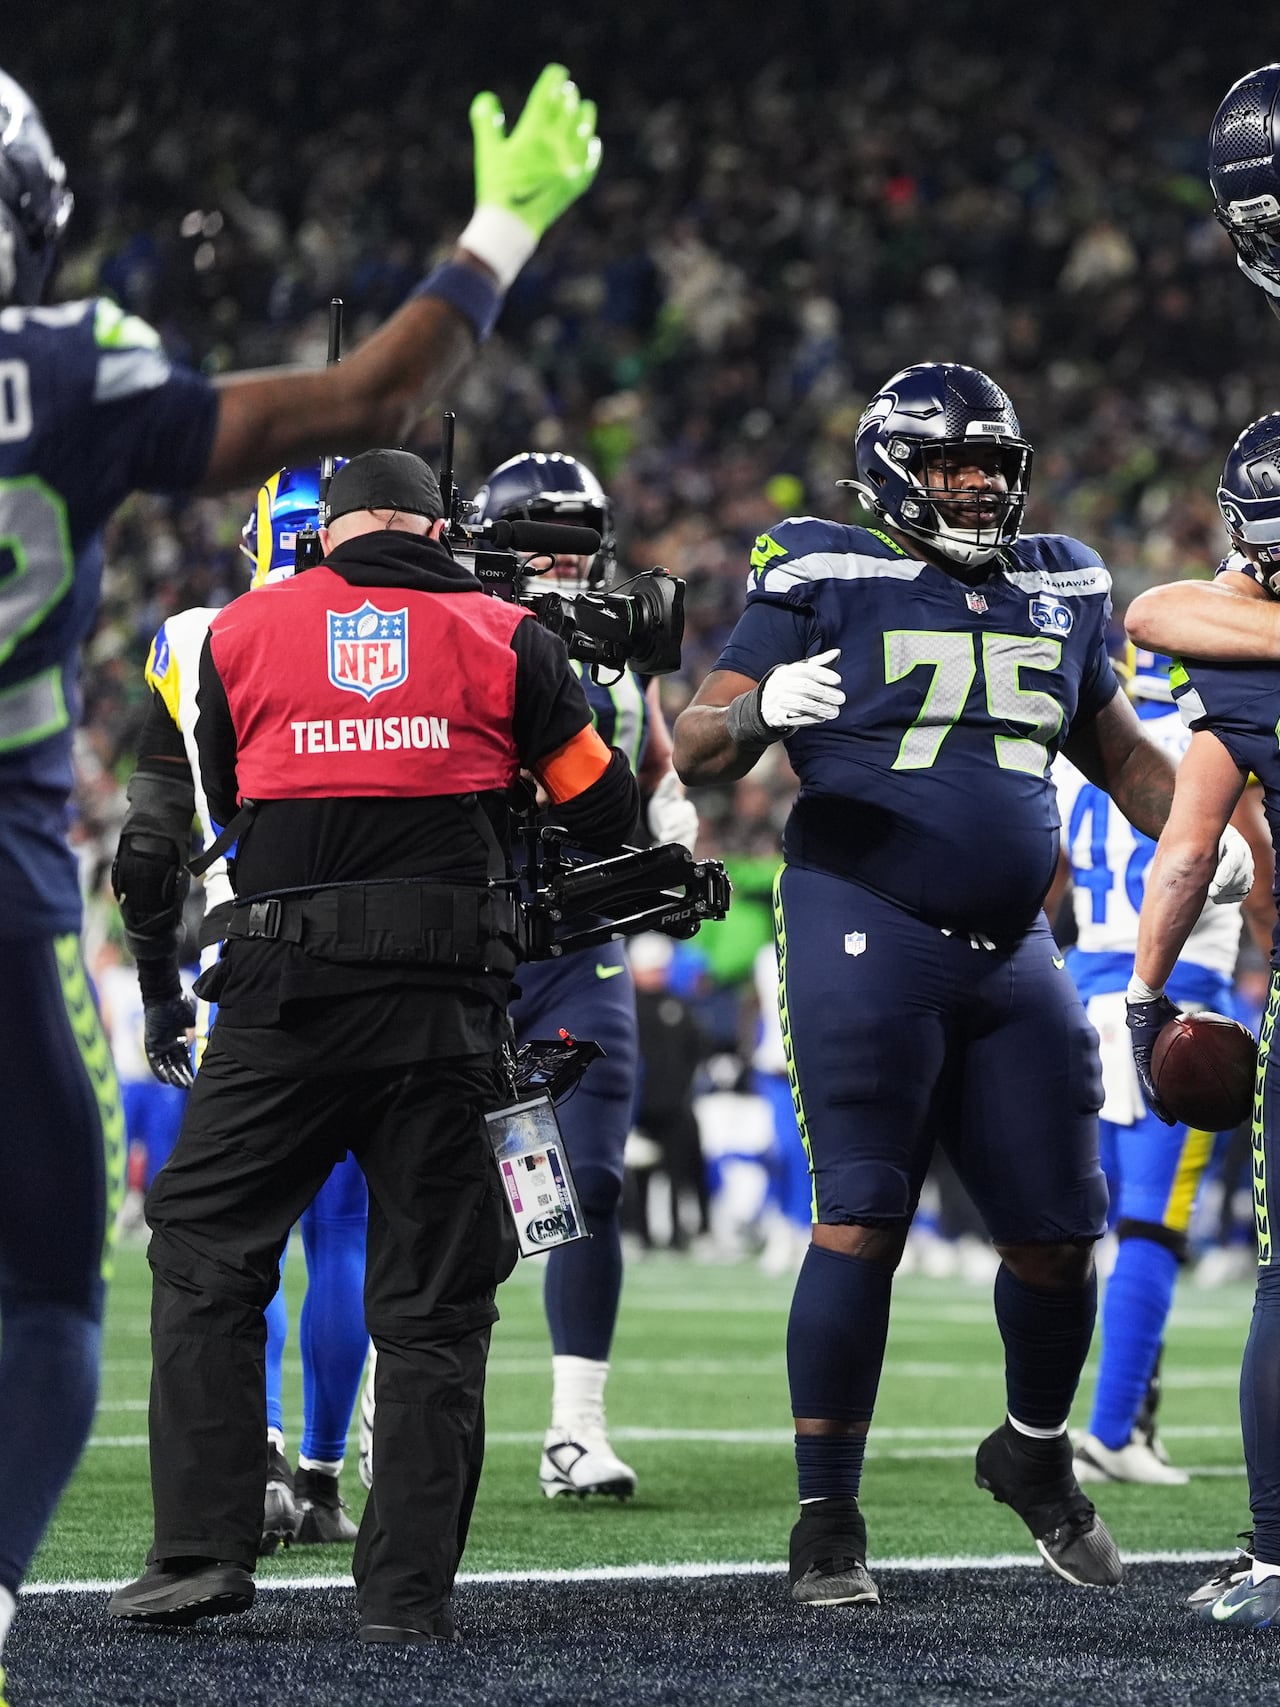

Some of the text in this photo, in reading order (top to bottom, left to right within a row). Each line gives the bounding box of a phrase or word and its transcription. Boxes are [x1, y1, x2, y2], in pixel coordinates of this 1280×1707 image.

[478, 568, 507, 578] SONY
[1032, 602, 1073, 632] 50
[338, 642, 399, 686] NFL
[883, 630, 1064, 778] 75
[290, 716, 451, 754] TELEVISION
[661, 908, 692, 926] PRO
[535, 1215, 567, 1234] FOX
